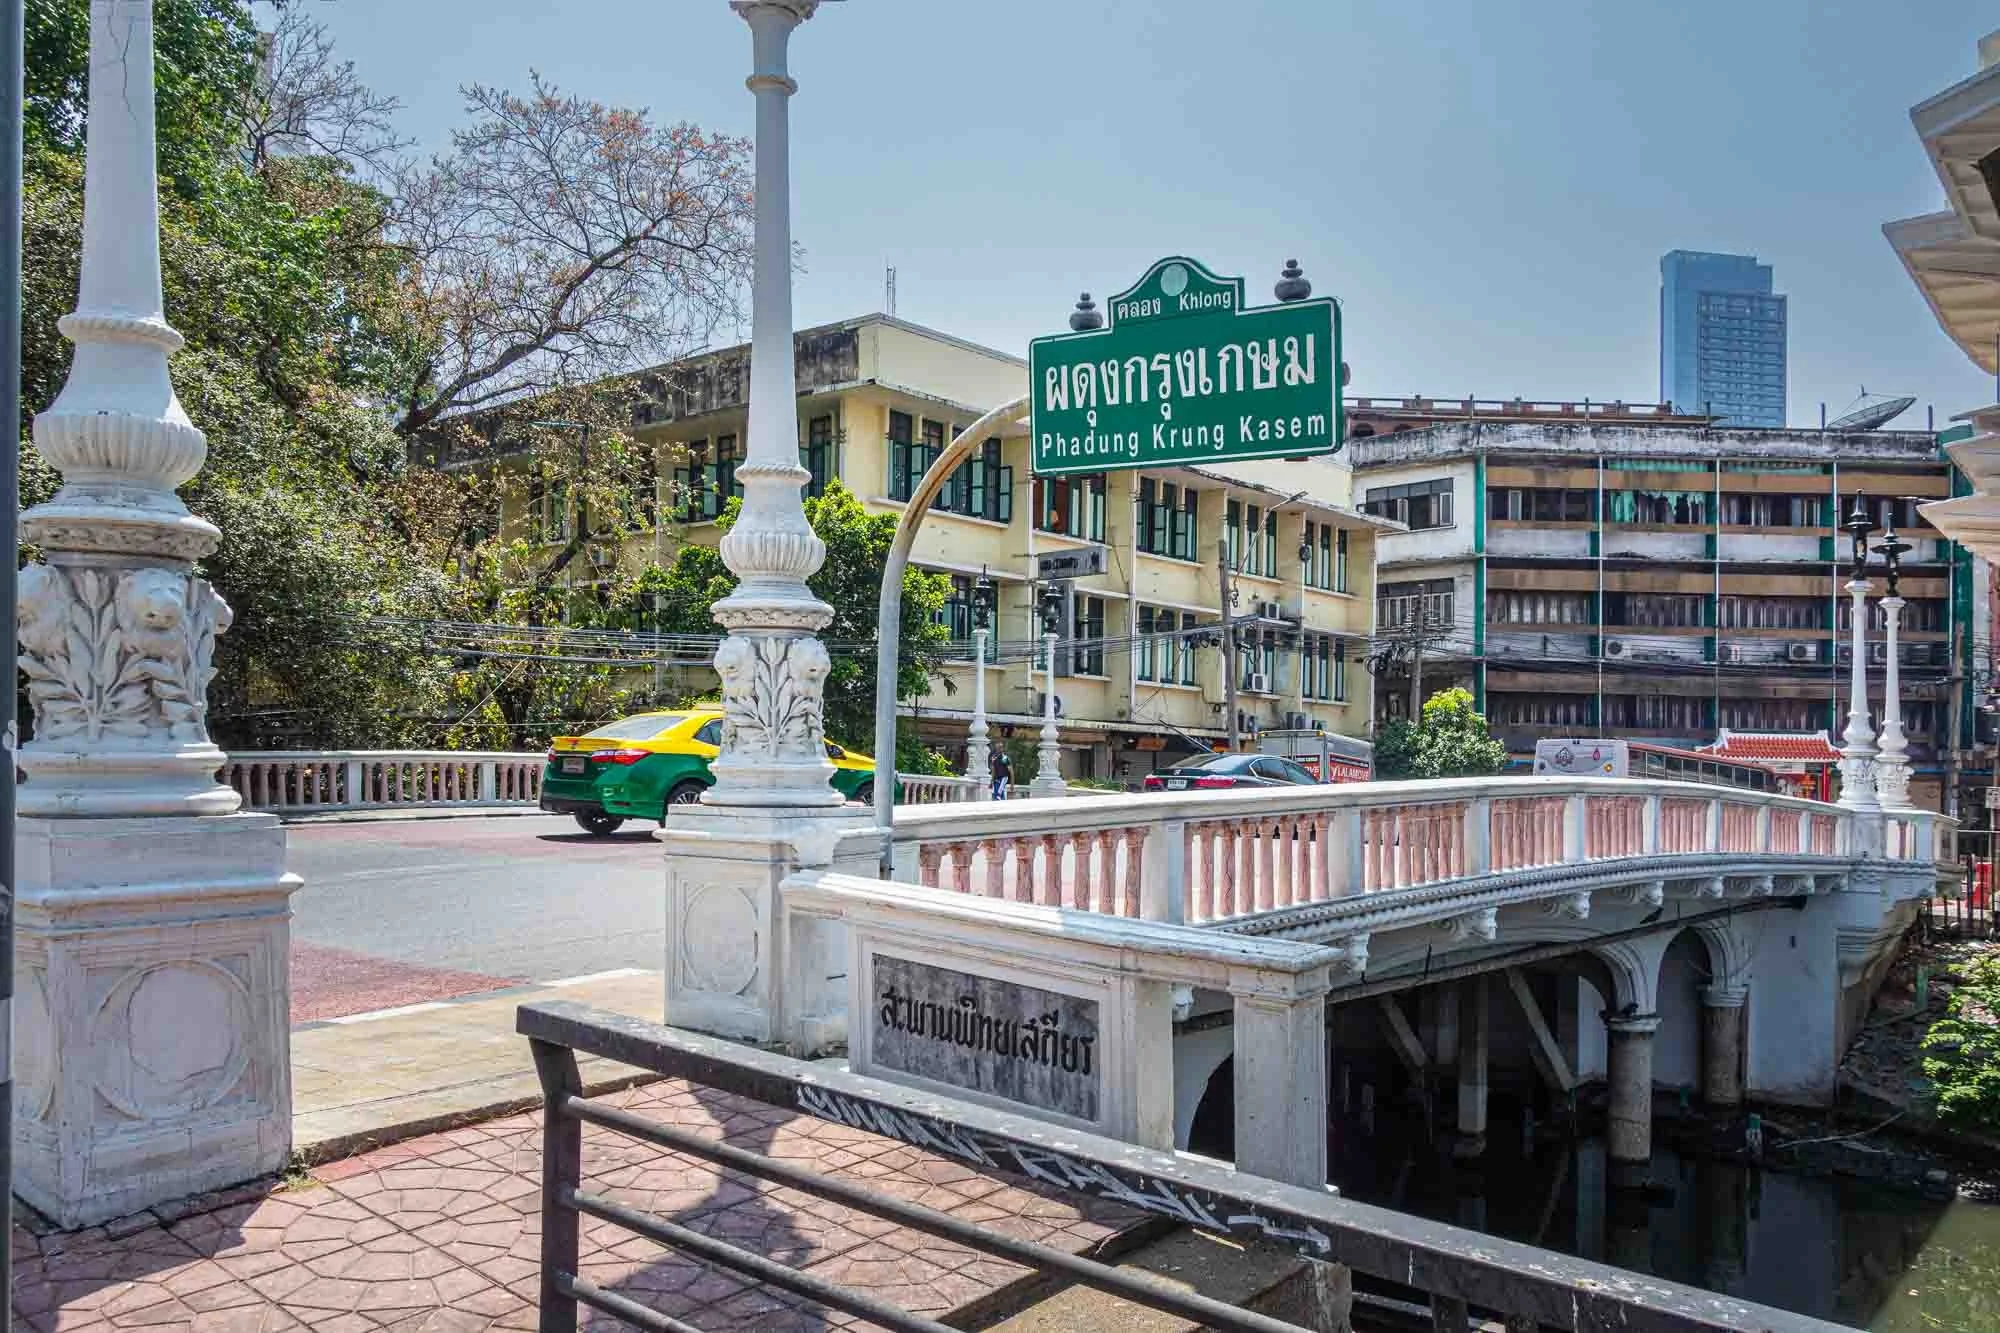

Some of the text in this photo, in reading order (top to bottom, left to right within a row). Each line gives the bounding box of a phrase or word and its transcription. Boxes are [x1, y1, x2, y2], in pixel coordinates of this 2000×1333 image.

[1118, 297, 1161, 320] คลอง
[1179, 290, 1232, 311] Khlong
[1045, 333, 1315, 427] ผดุงกรุงเกษม
[1041, 413, 1325, 458] Phadung Krung Kasem
